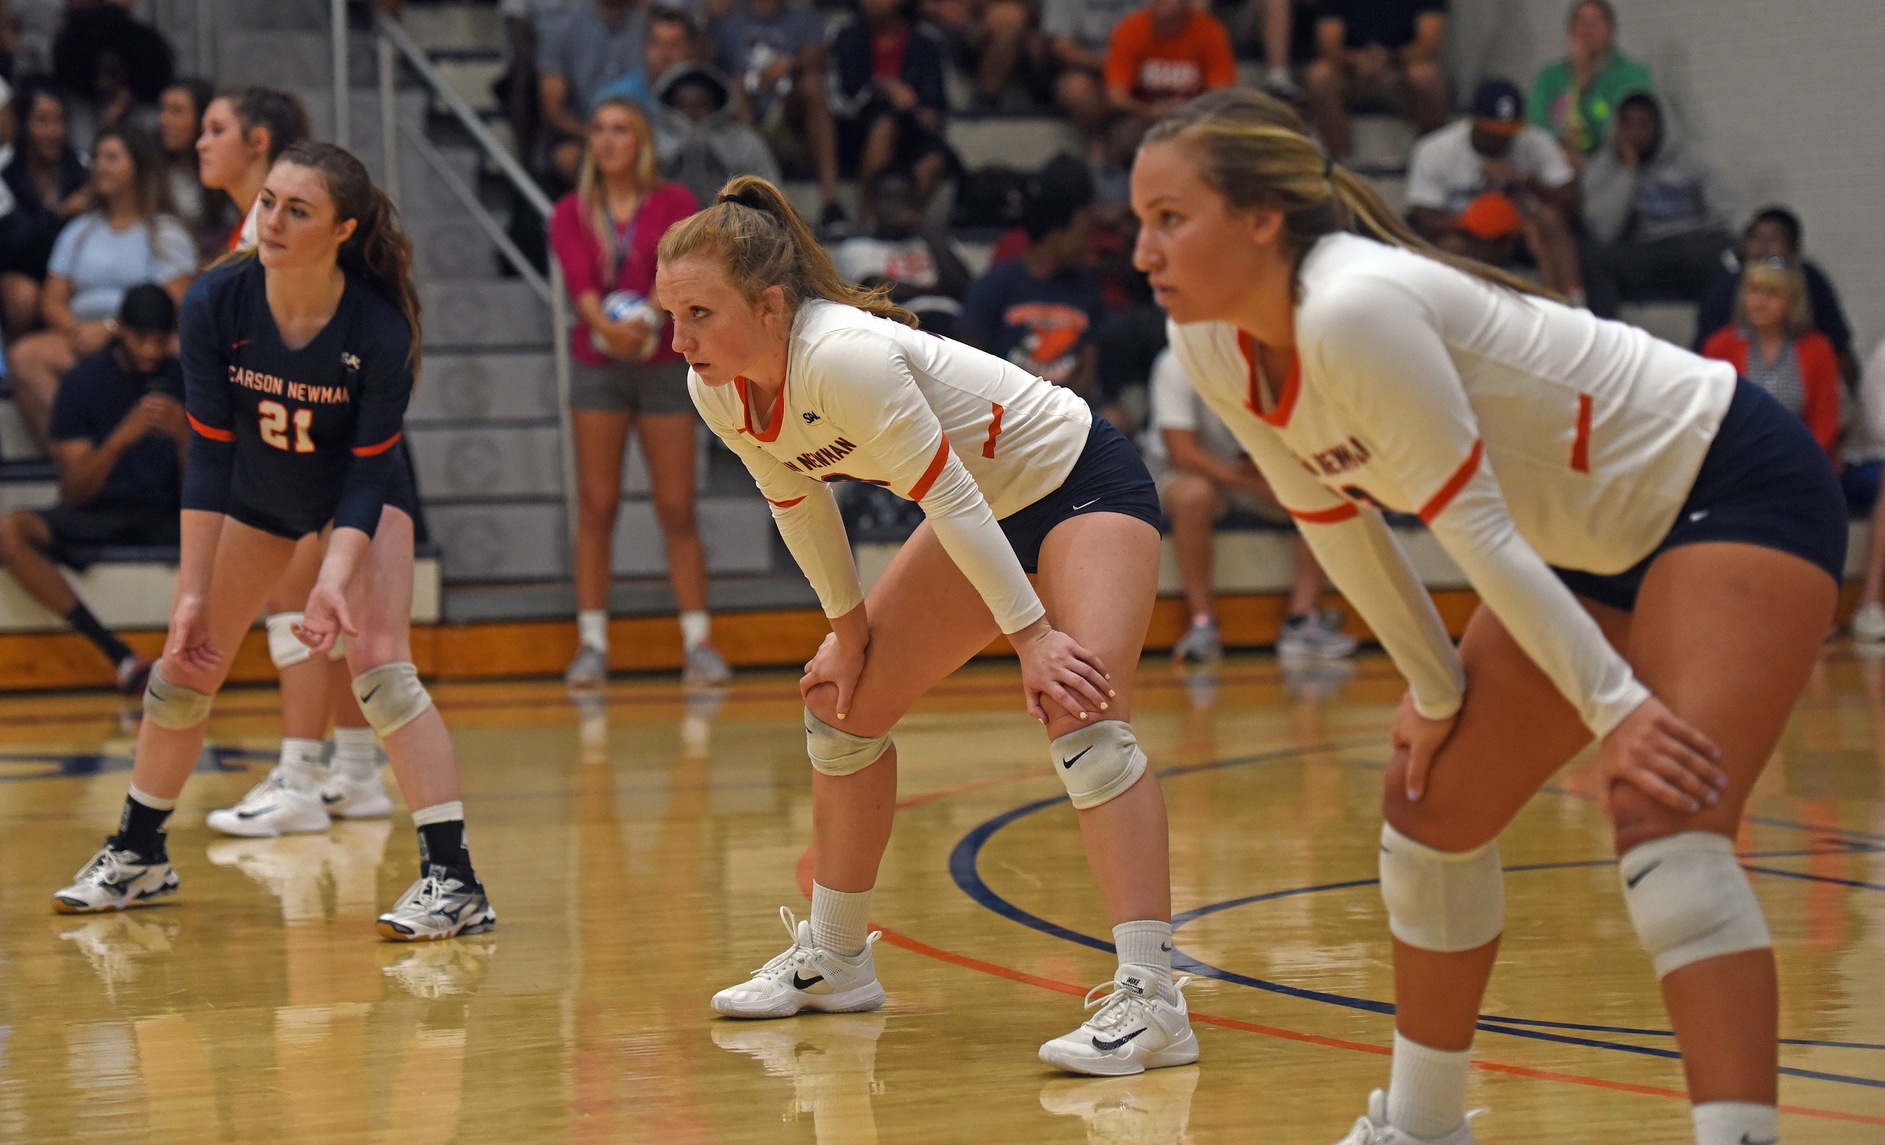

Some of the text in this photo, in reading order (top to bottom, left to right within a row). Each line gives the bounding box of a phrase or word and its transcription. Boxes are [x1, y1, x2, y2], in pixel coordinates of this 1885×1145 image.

[228, 365, 284, 396] CARSON
[258, 399, 316, 453] 21
[796, 436, 857, 471] NEWMAN
